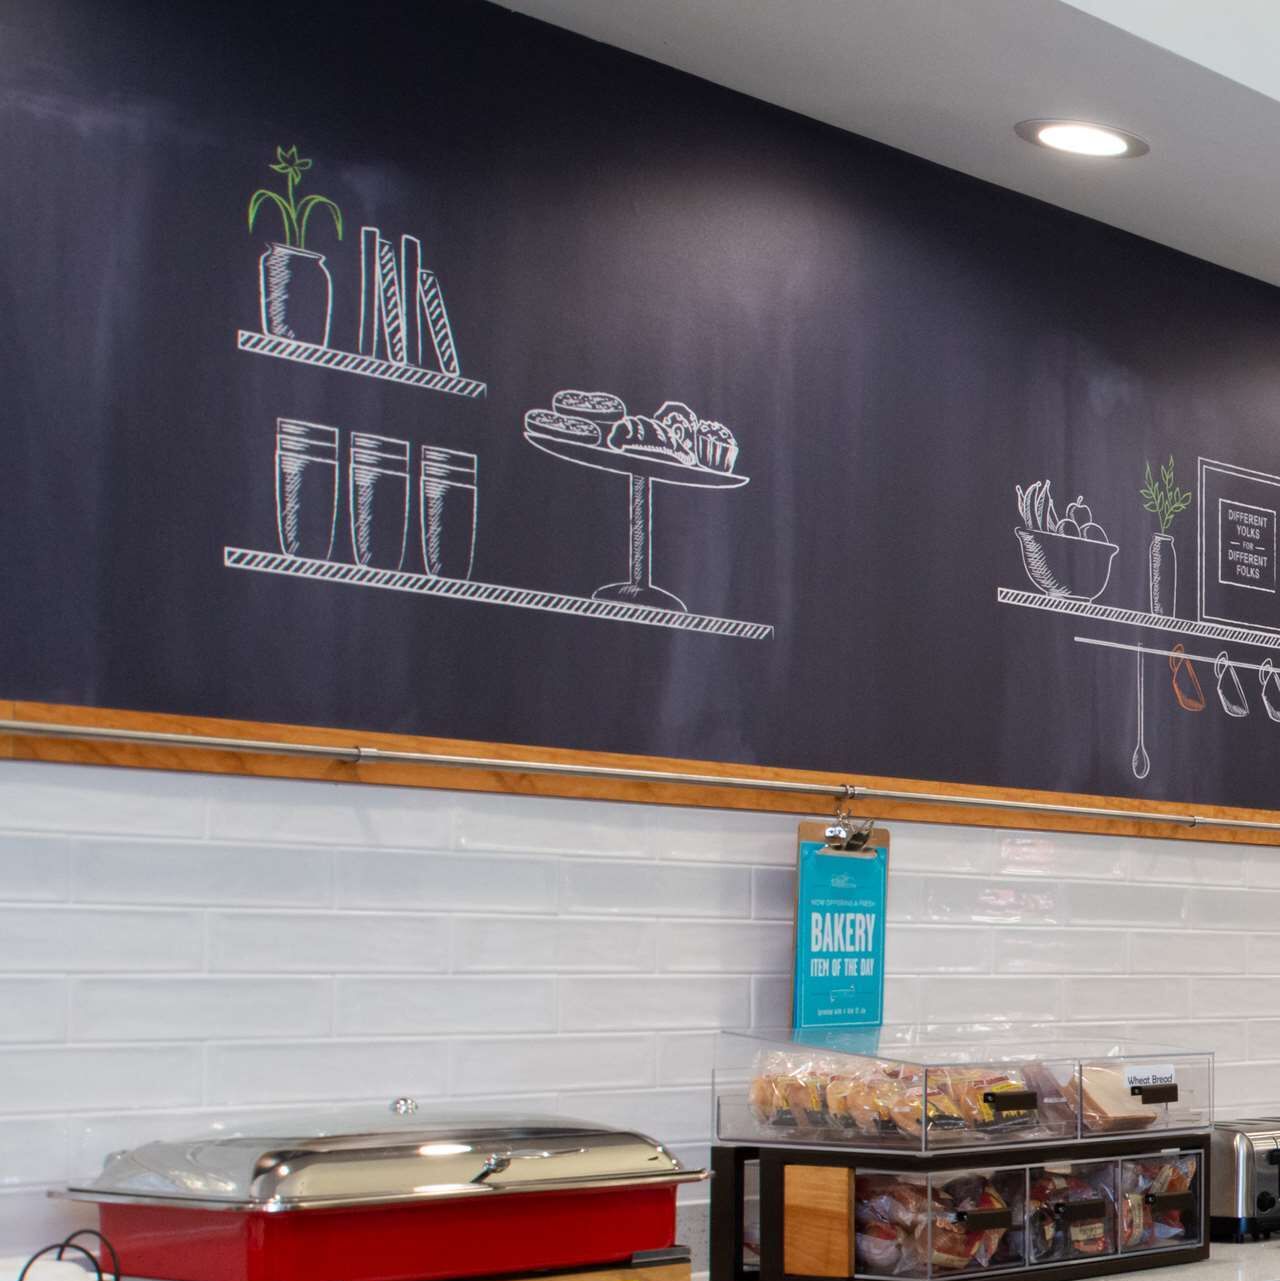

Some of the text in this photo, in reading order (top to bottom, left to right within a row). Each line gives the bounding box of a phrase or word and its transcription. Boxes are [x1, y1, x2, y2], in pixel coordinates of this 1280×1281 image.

[1228, 509, 1268, 528] DIFFERENT
[1236, 524, 1261, 539] YOLKS
[1242, 541, 1254, 551] FOR
[1228, 549, 1268, 568] DIFFERENT
[1236, 564, 1260, 579] FOLKS
[811, 911, 876, 952] BAKERY
[810, 958, 875, 976] ITEM OF THE DAY
[1128, 1073, 1173, 1085] Wheat Bread
